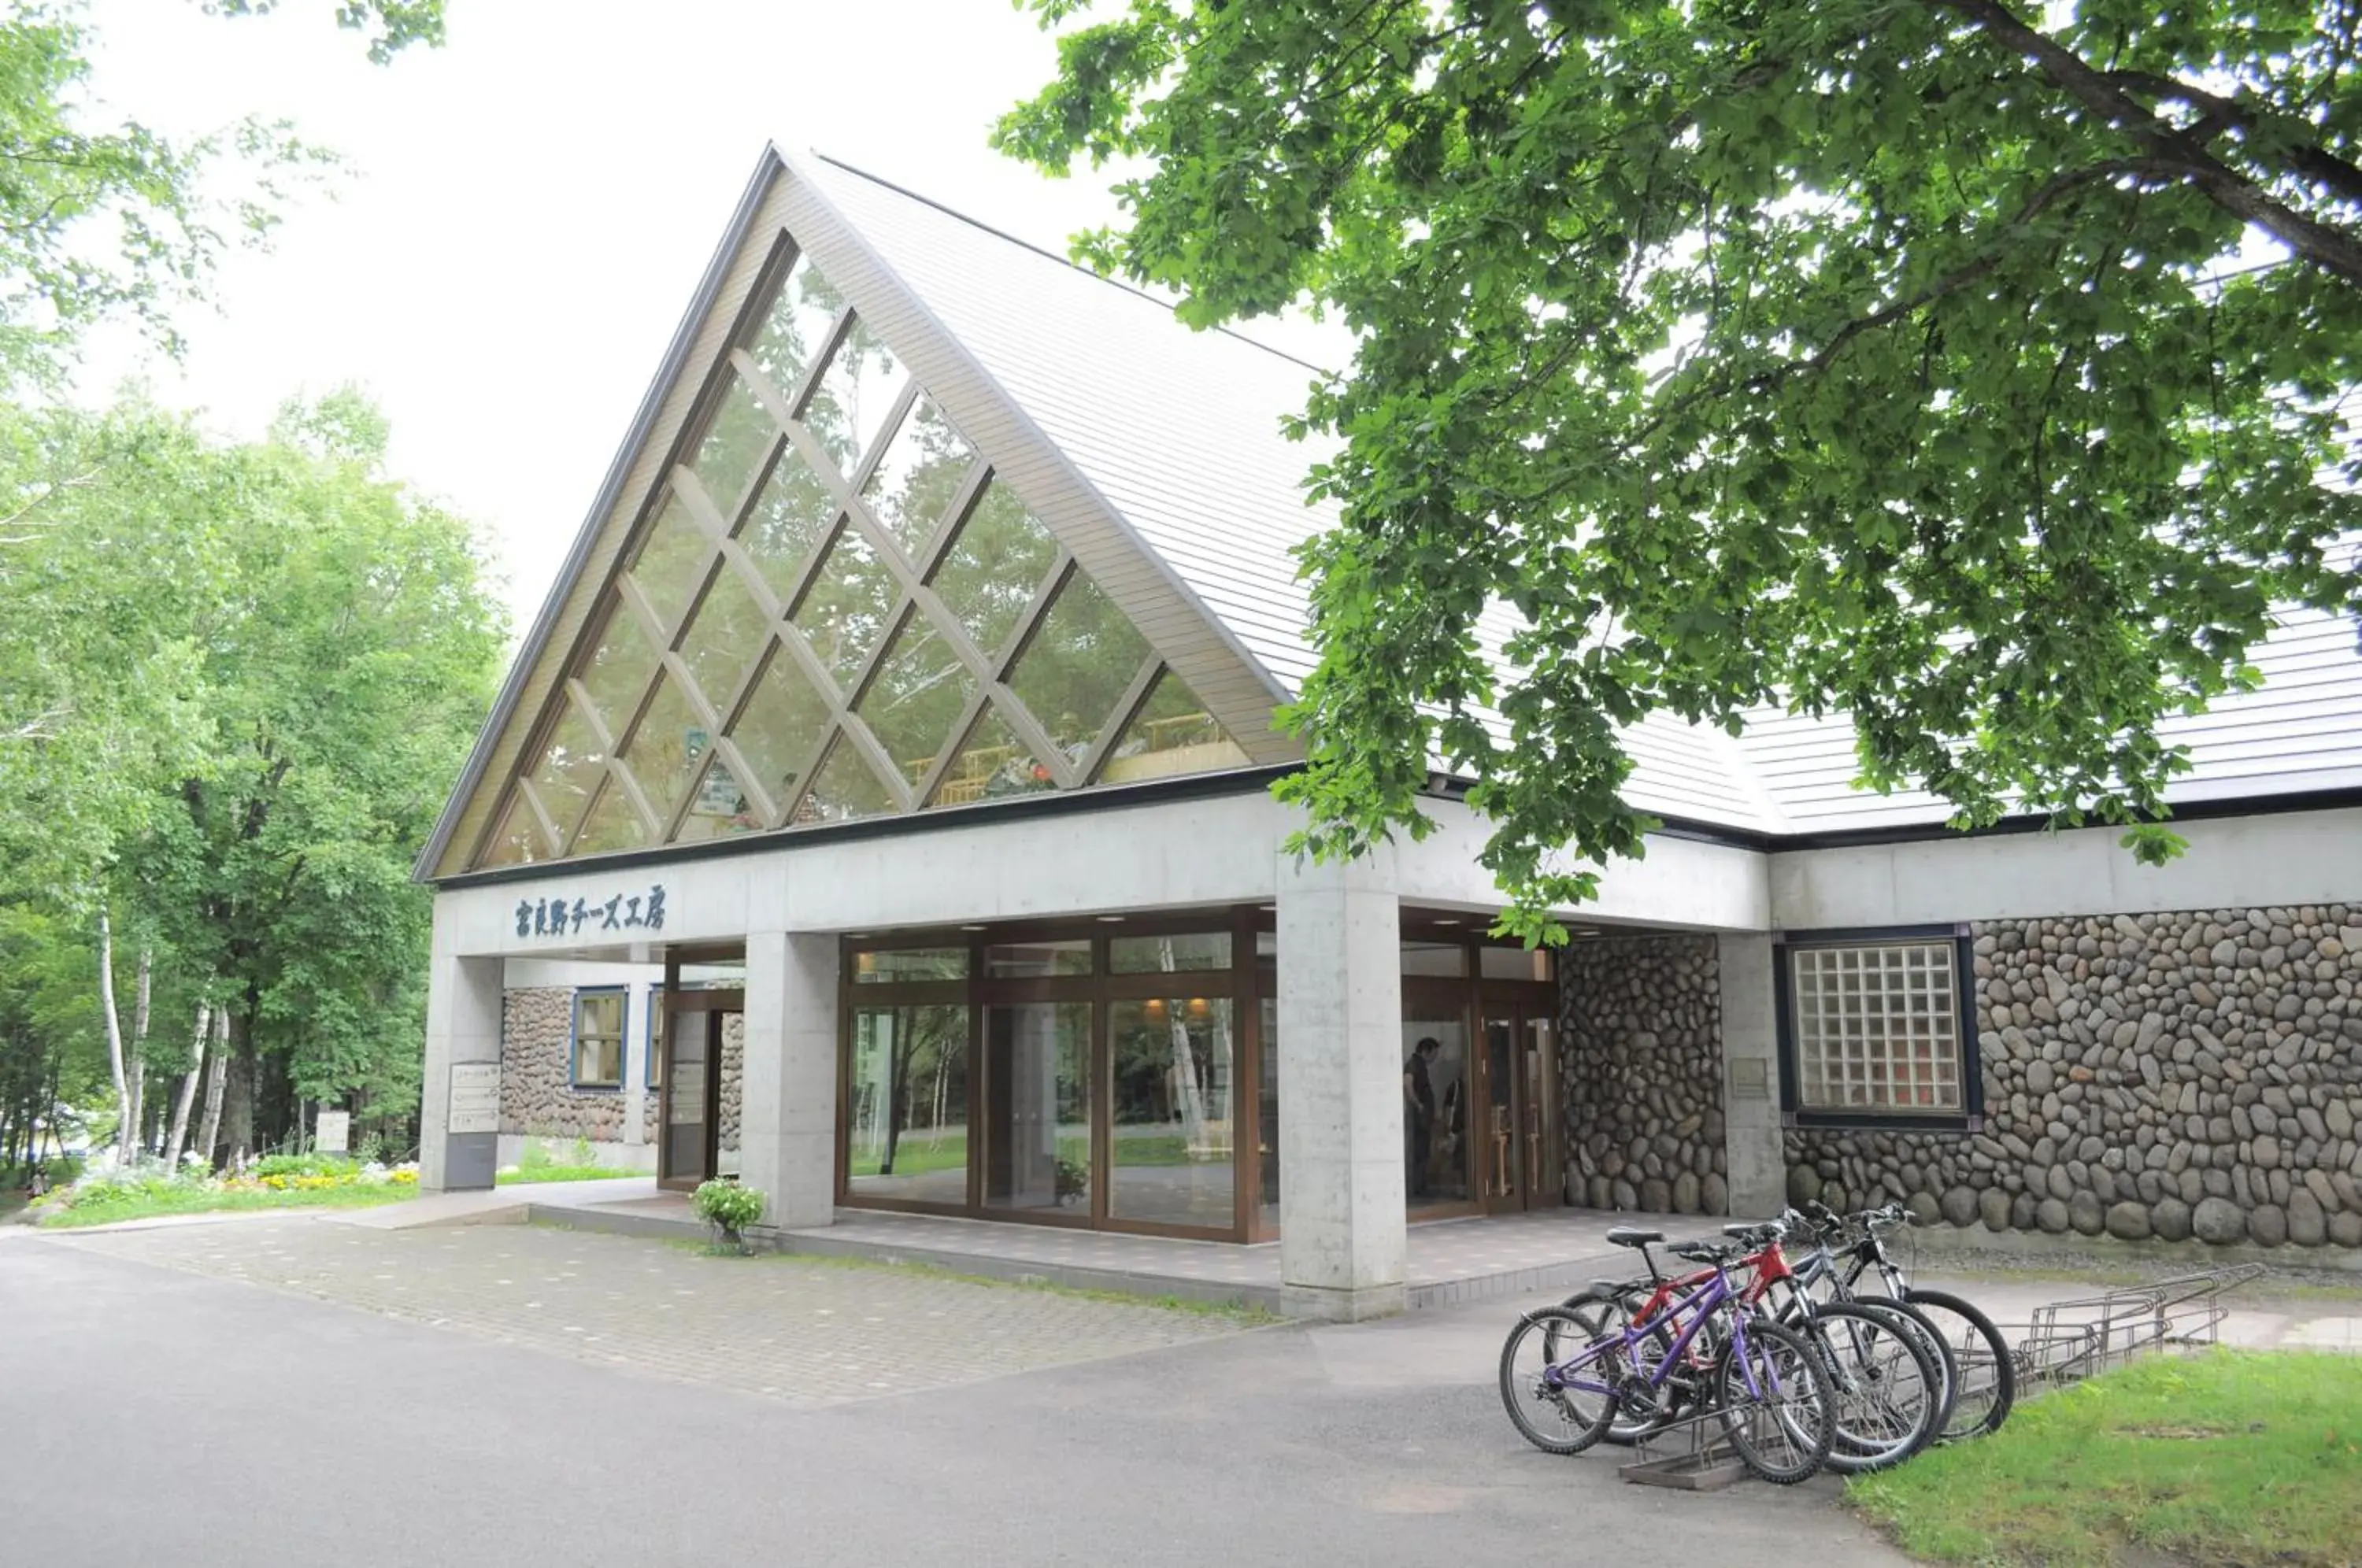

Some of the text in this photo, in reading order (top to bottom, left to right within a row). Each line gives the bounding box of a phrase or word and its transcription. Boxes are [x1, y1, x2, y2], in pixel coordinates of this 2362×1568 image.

[516, 884, 665, 937] 富良野チーズ工房
